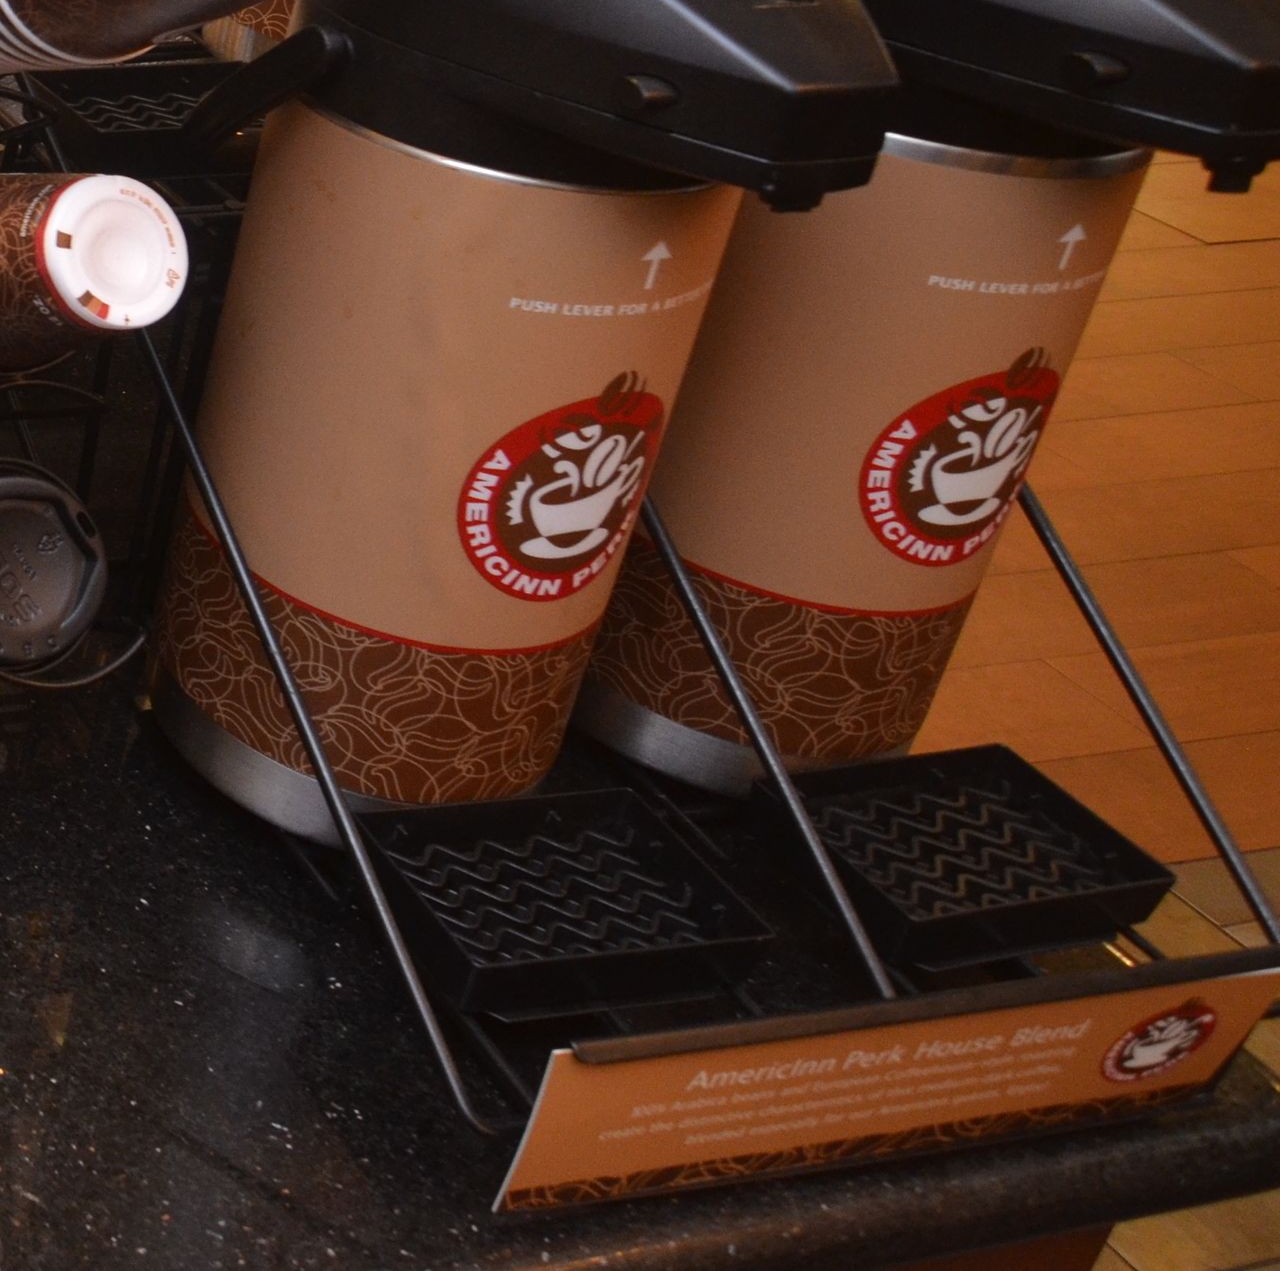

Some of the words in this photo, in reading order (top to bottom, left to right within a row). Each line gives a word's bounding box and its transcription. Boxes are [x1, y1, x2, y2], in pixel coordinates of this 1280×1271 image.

[510, 297, 557, 315] PUSH
[561, 303, 614, 317] LEVER
[618, 303, 648, 316] FOR
[652, 301, 661, 312] A
[928, 275, 976, 291] PUSH
[978, 281, 1028, 295] LEVER
[1032, 281, 1059, 294] FOR
[466, 448, 563, 596] AMERICINN
[867, 418, 955, 561] AMERICINN
[686, 1056, 837, 1091] AmericInn
[842, 1045, 906, 1071] Perk
[913, 1034, 1005, 1062] House
[1010, 1018, 1093, 1048] Blend
